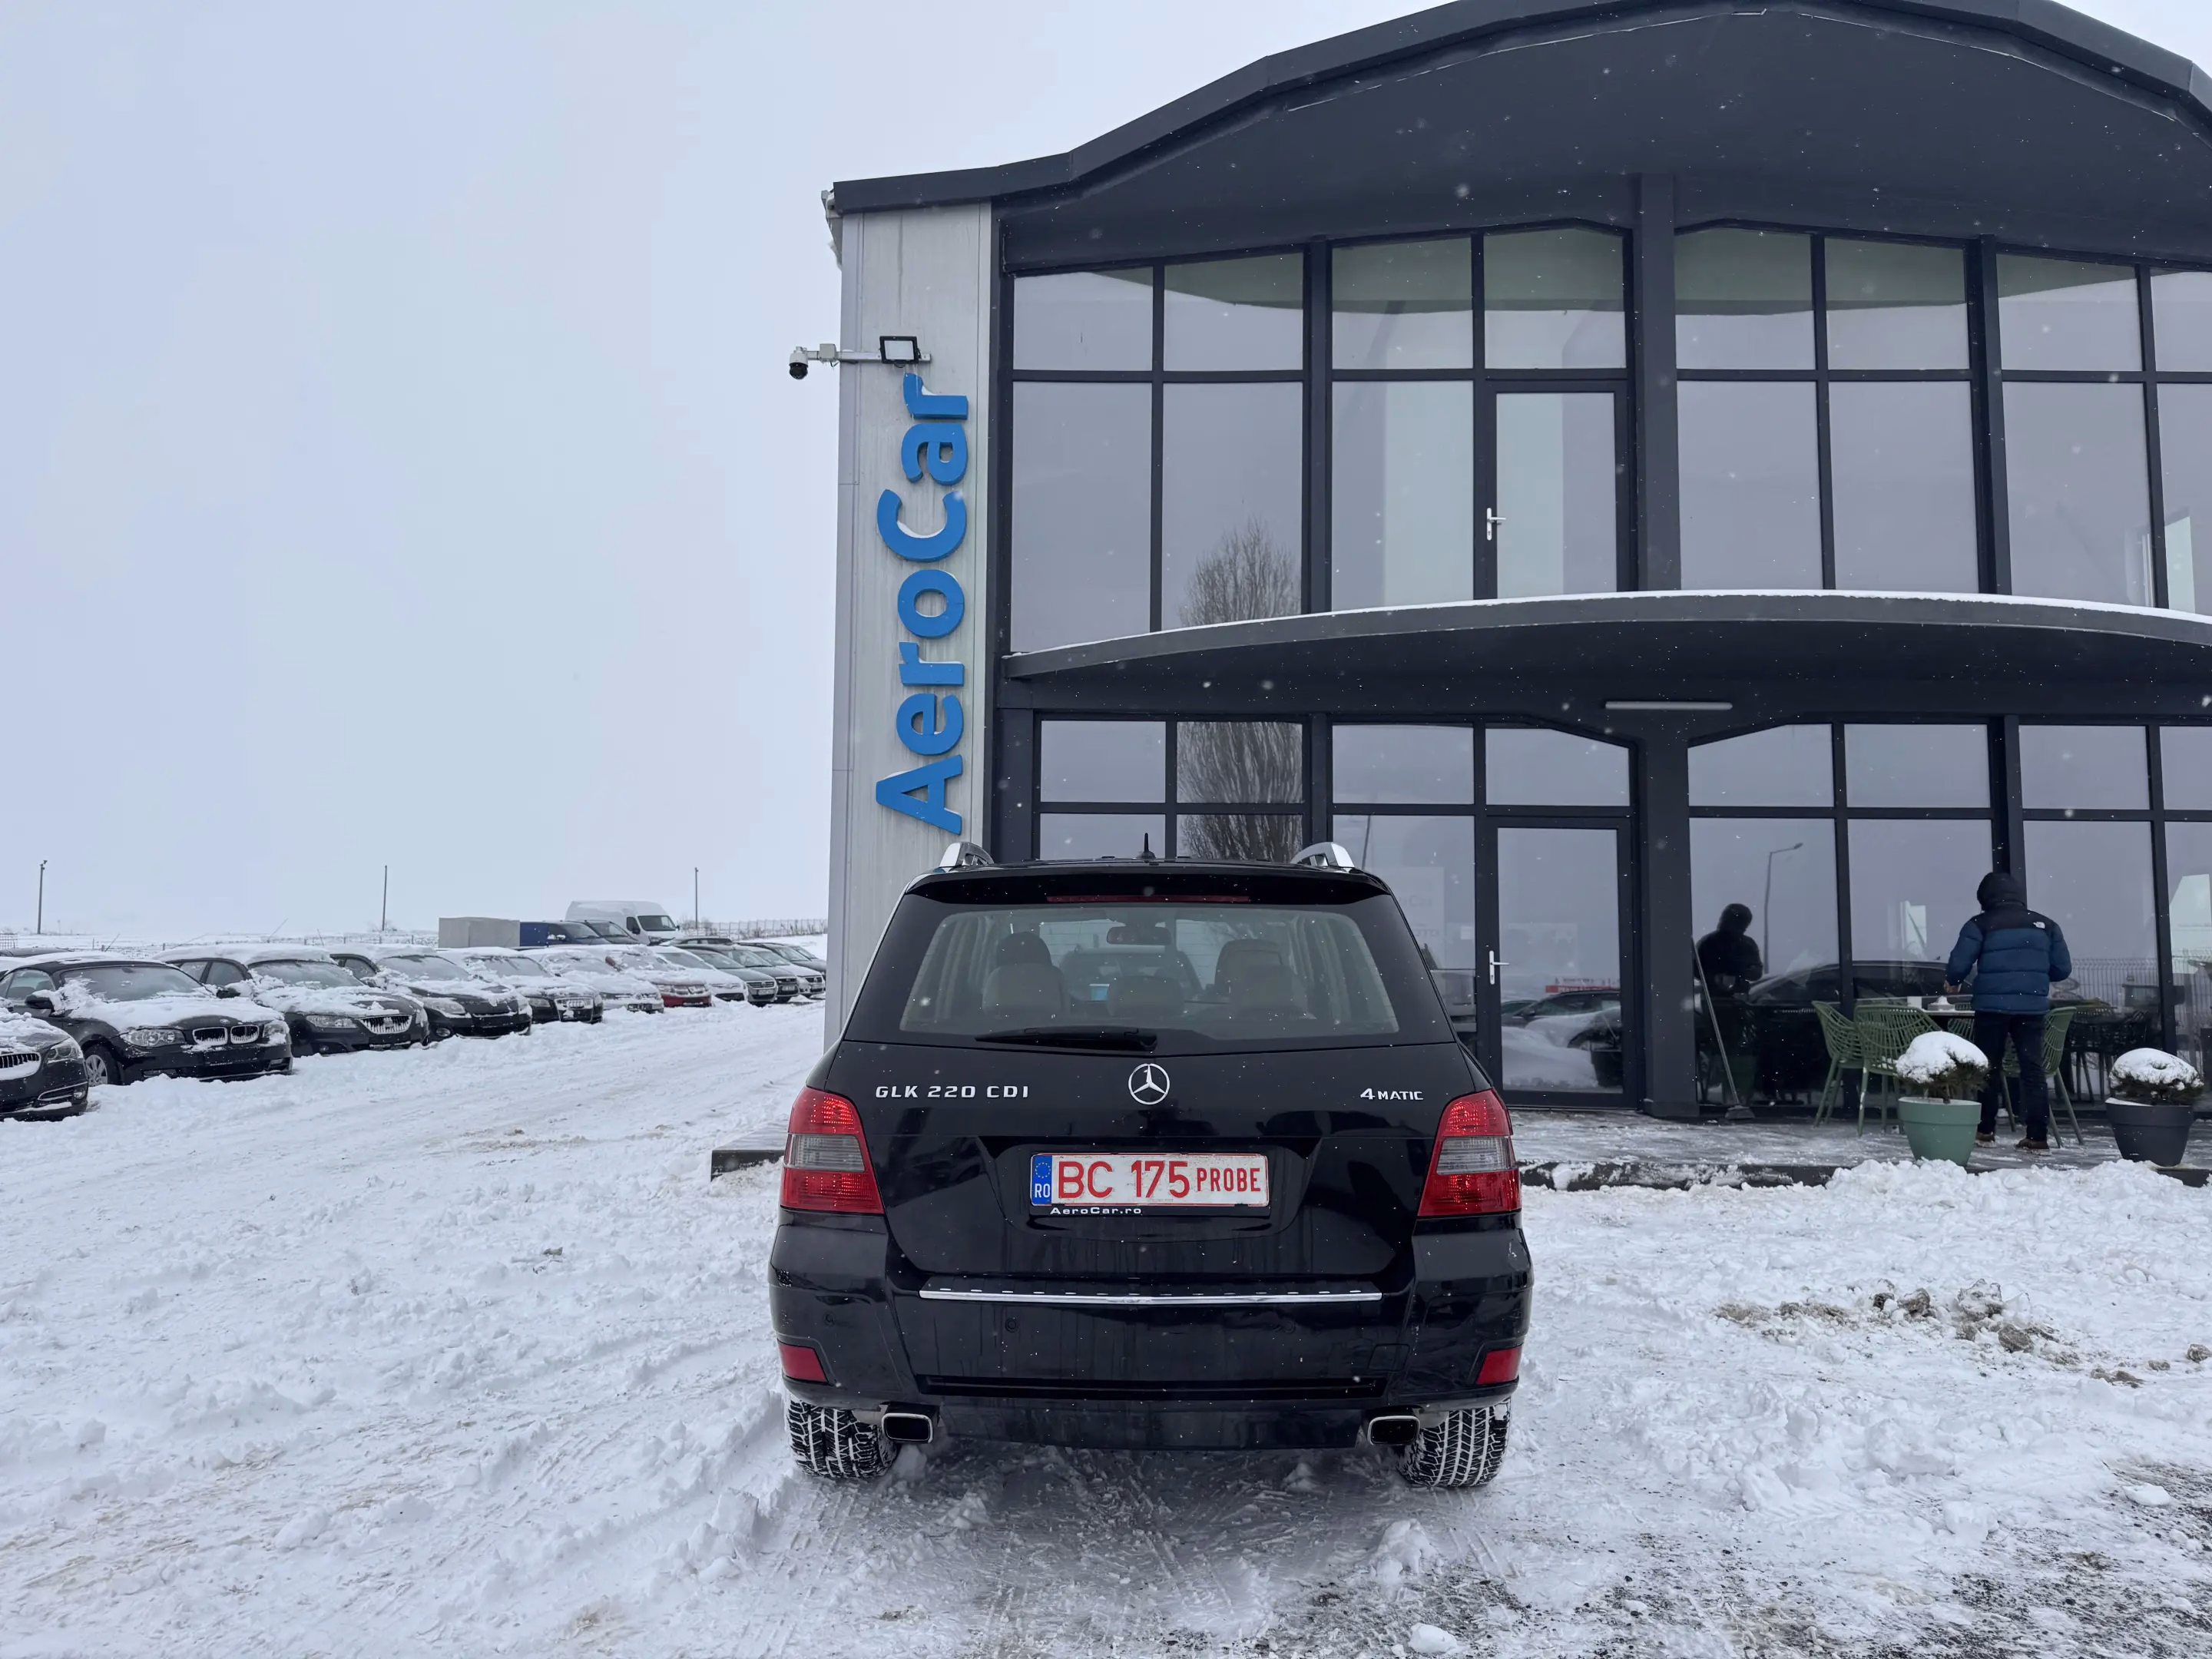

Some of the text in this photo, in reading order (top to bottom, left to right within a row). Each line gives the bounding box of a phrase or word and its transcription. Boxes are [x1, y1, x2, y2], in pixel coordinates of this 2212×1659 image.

[876, 373, 969, 835] AeroCar
[876, 1085, 1028, 1098] GLK 220 CDI
[1359, 1088, 1424, 1101] 4MATIC
[1058, 1160, 1261, 1199] BC 175 PROBE
[1034, 1183, 1051, 1198] RO
[1050, 1207, 1142, 1215] AeroCar.ro
